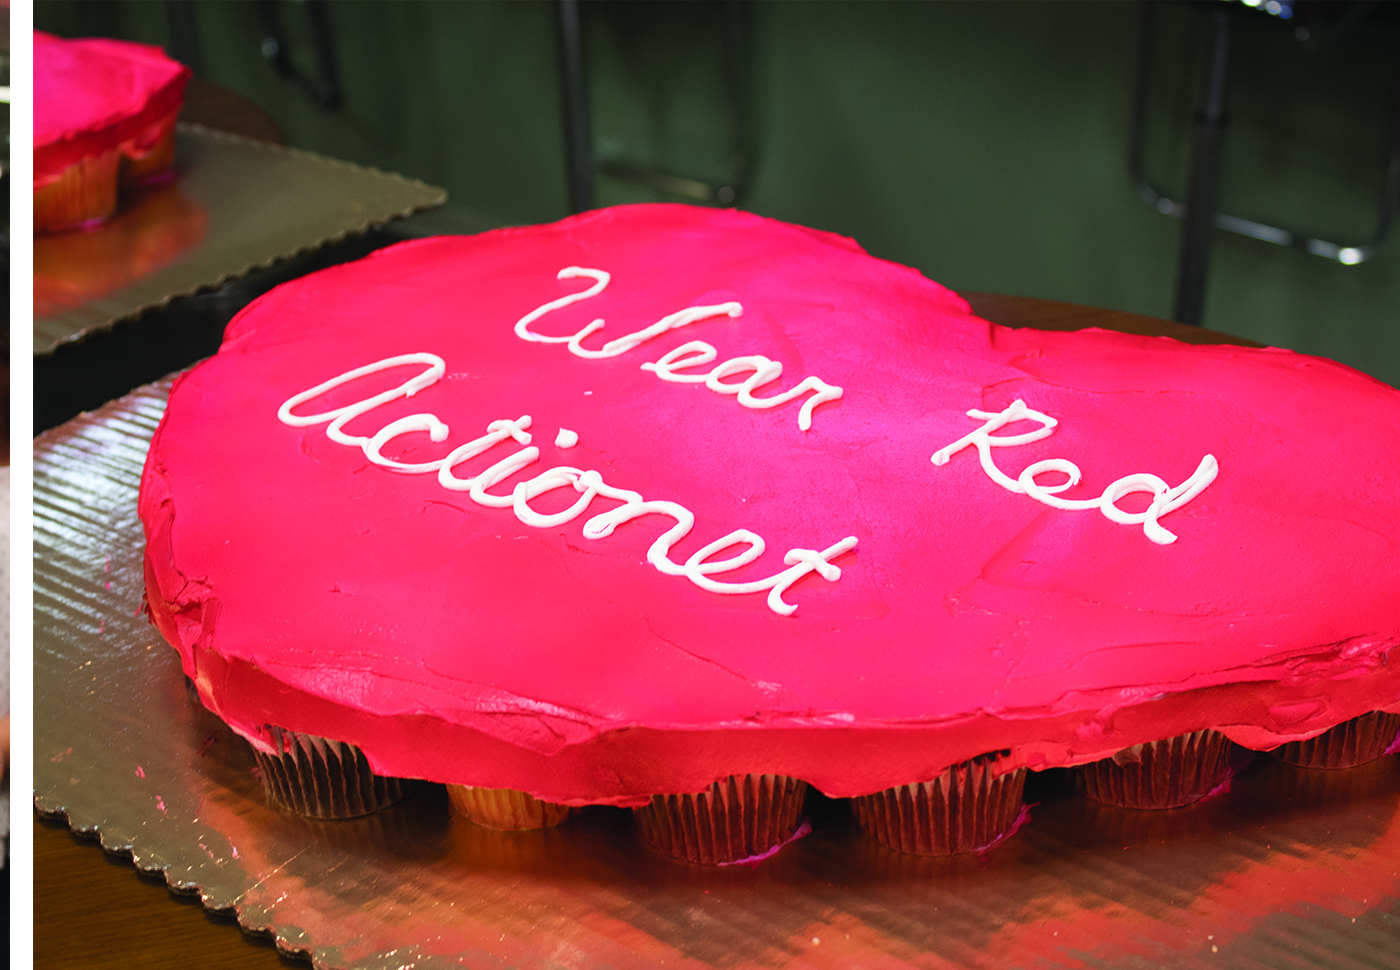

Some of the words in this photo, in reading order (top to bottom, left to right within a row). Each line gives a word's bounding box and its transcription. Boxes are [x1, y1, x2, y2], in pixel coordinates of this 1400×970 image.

[278, 353, 858, 614] Actionet
[515, 267, 842, 430] Wear
[931, 399, 1218, 544] Red
